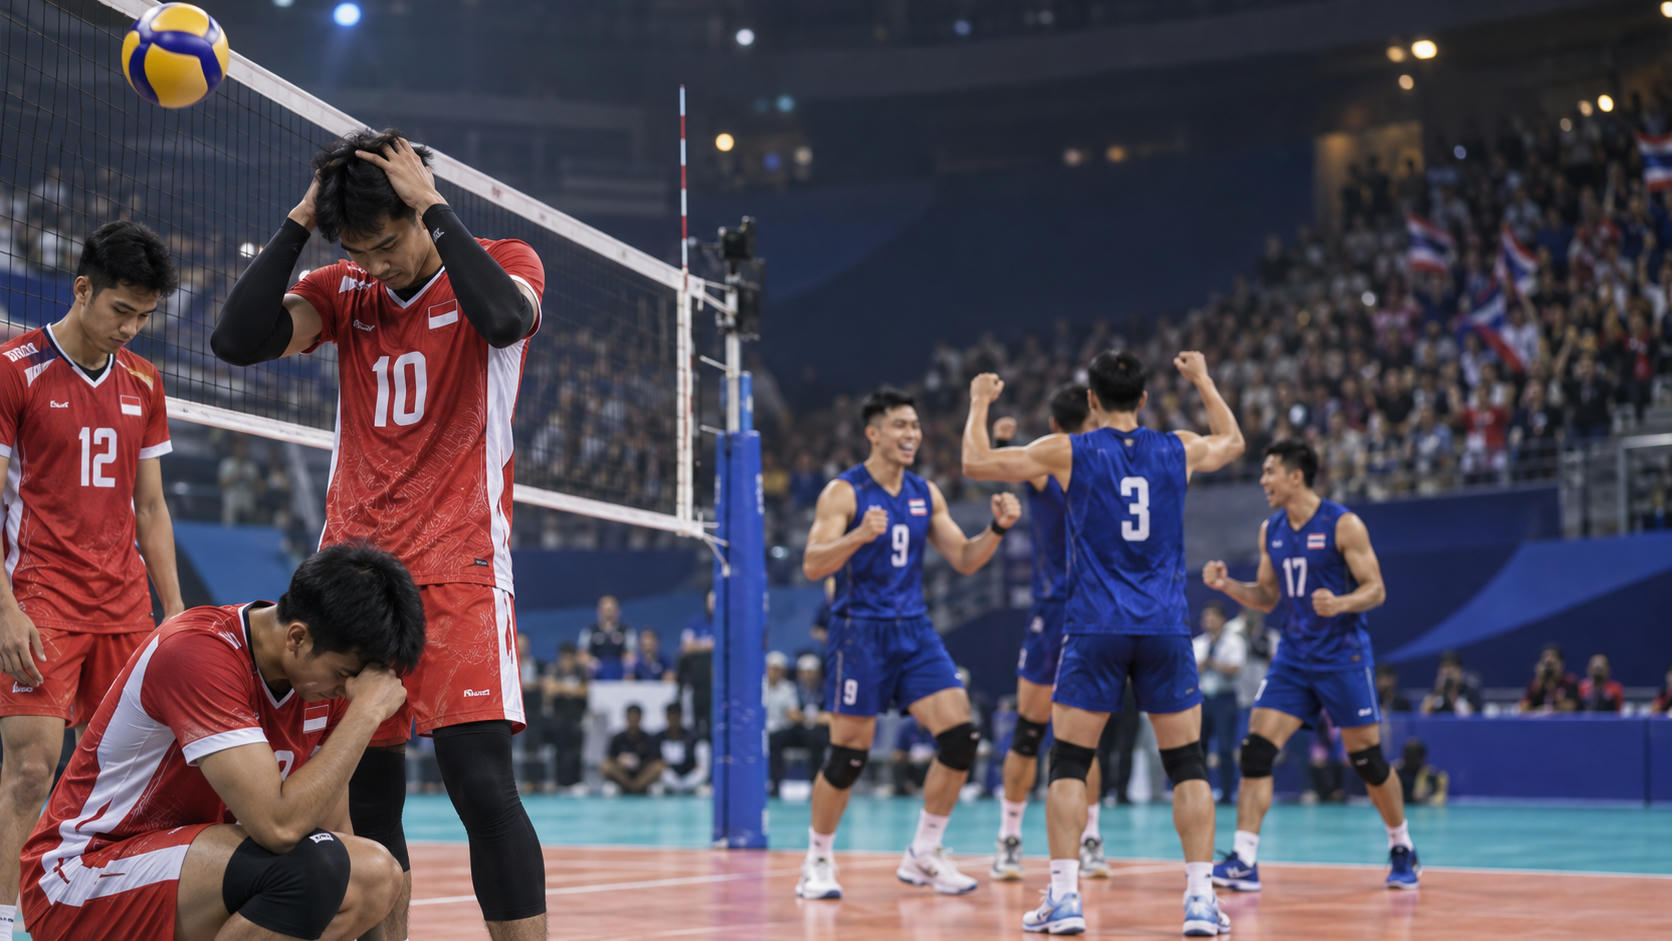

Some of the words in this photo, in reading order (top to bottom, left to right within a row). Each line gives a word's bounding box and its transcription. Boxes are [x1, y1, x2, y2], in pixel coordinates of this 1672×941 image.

[372, 351, 427, 428] 10
[78, 426, 118, 488] 12
[1120, 476, 1150, 541] 3
[891, 523, 910, 567] 9
[1282, 557, 1307, 597] 17
[843, 679, 858, 705] 9
